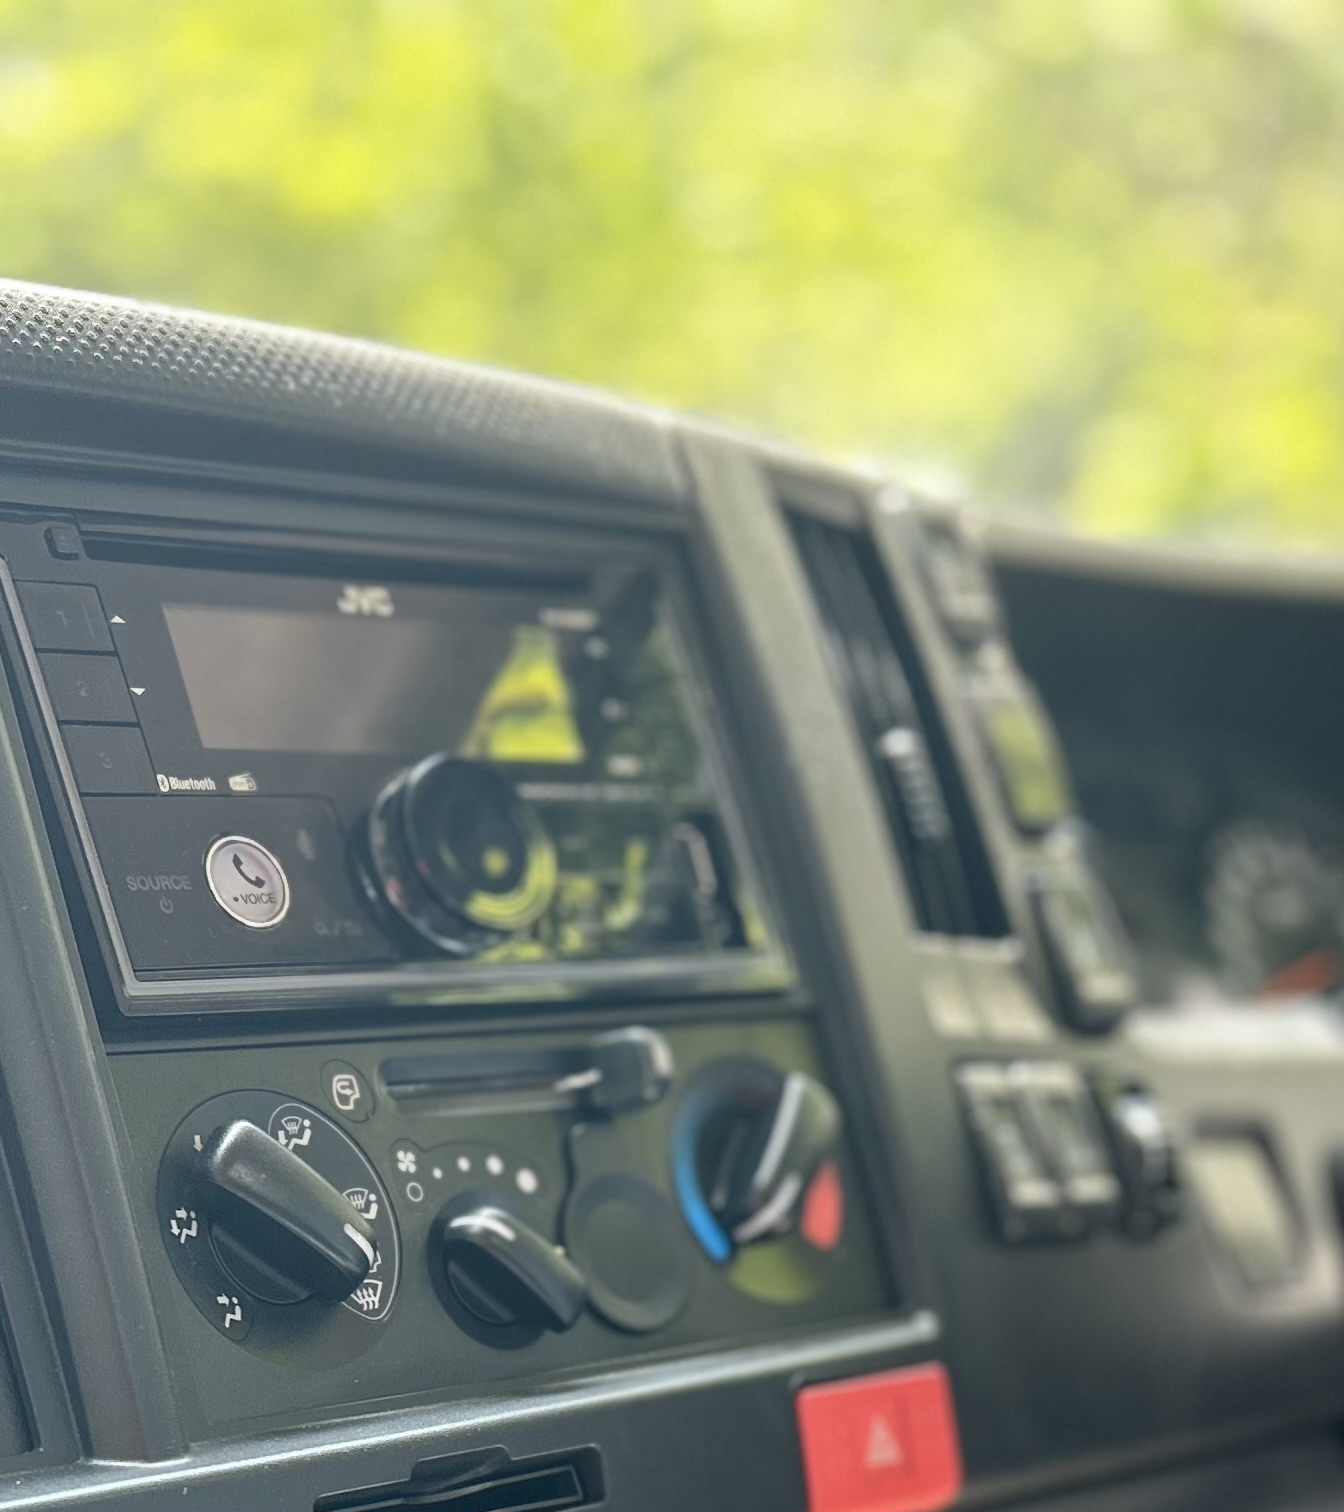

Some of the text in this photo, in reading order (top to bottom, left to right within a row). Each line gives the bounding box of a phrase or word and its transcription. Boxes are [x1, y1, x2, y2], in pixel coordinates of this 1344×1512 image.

[168, 776, 217, 791] Bluetooth
[126, 874, 193, 891] SOURCE
[239, 892, 277, 905] VOICE
